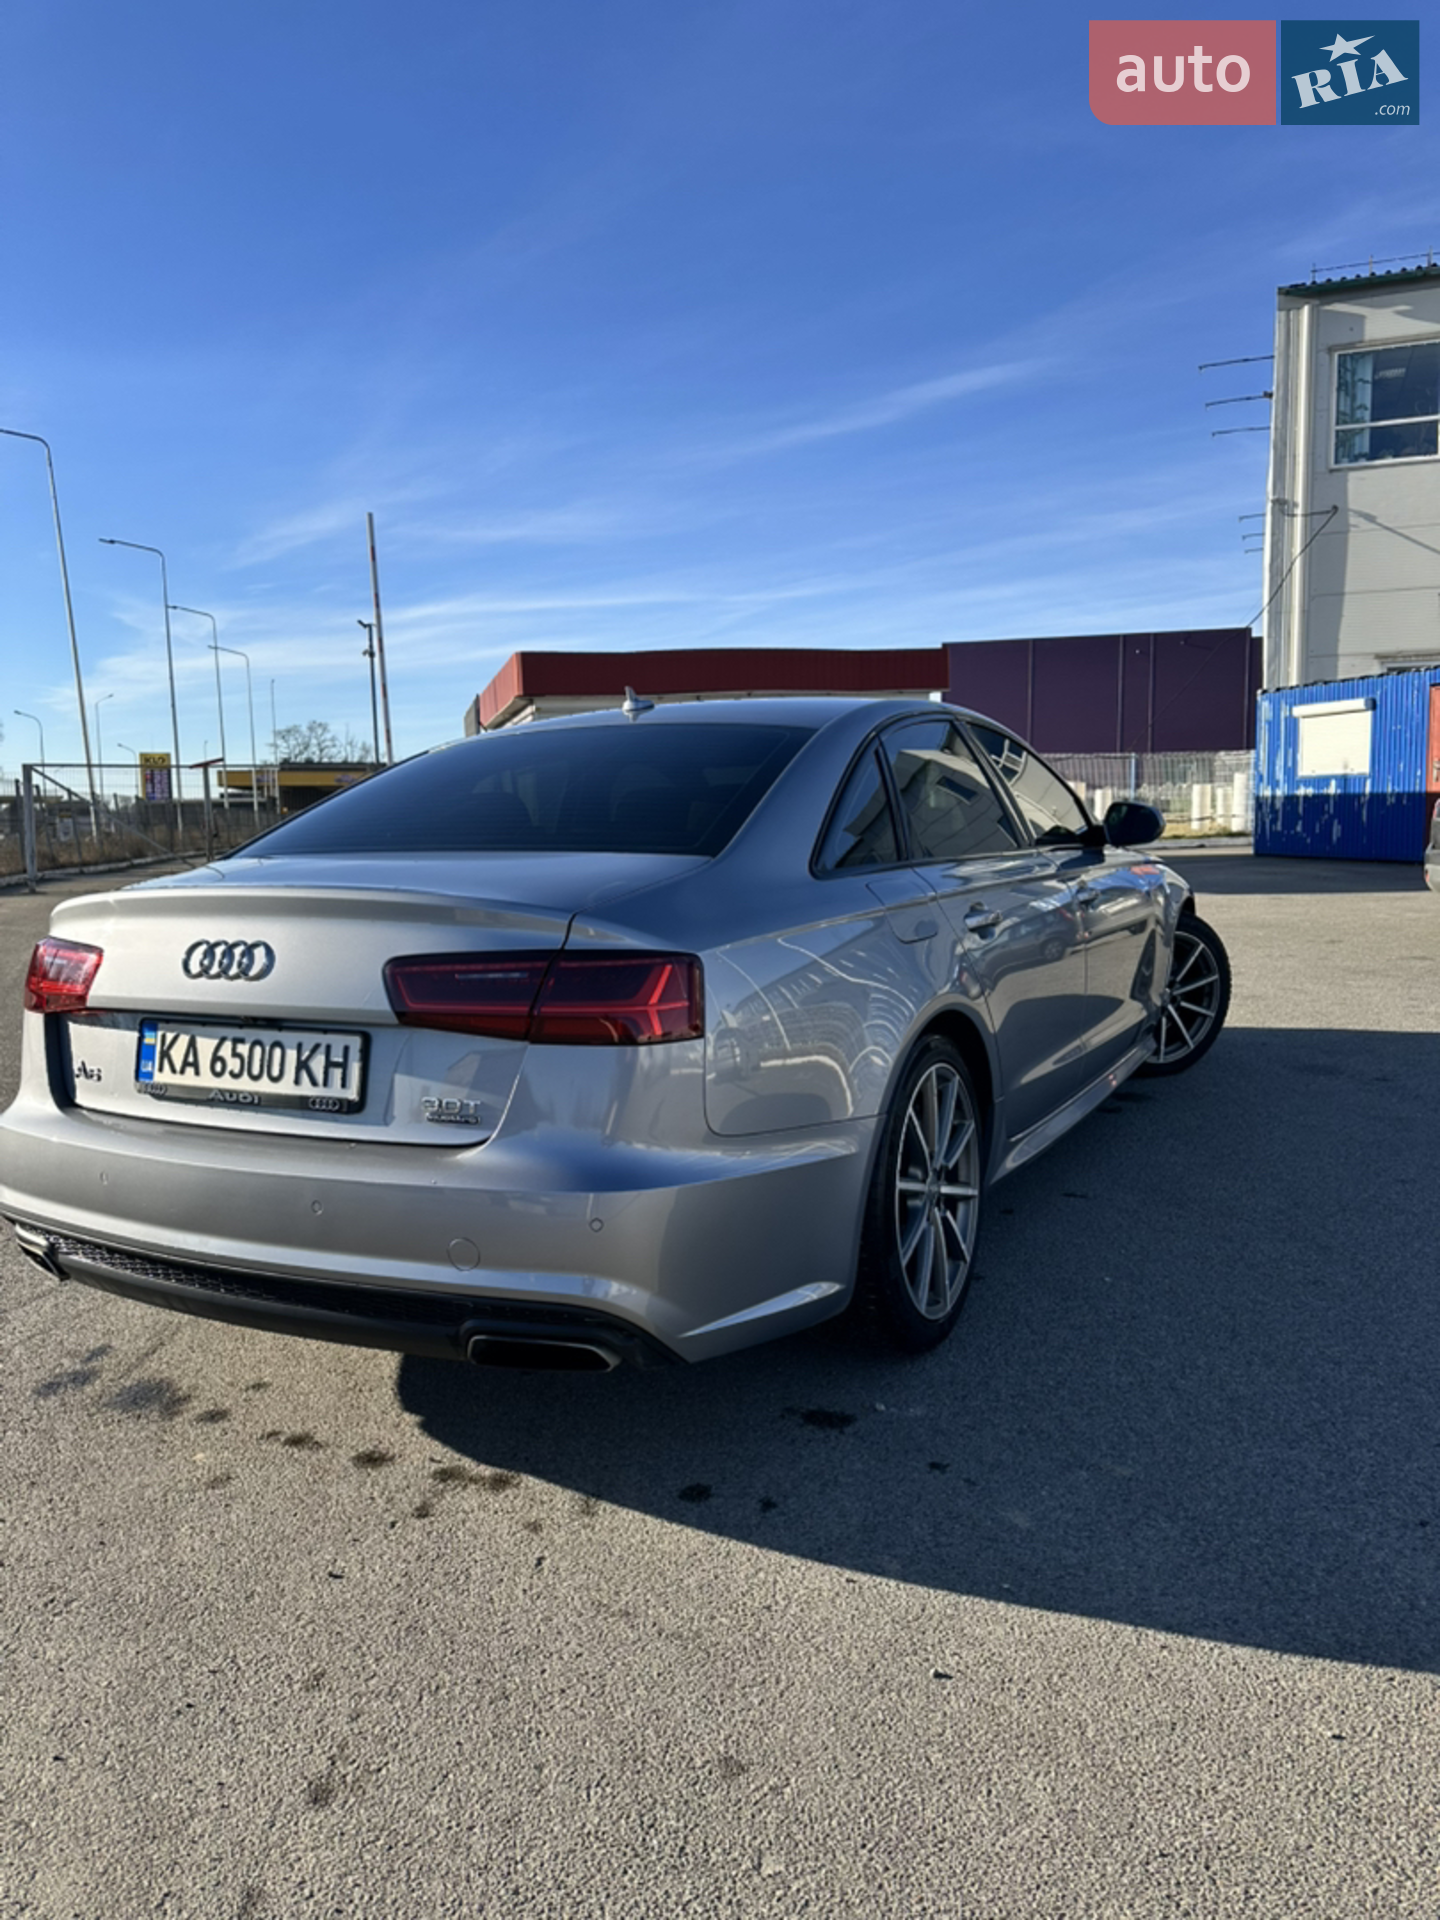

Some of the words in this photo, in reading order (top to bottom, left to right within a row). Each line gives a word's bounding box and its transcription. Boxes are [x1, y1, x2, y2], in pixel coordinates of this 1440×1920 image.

[158, 1032, 200, 1077] KA
[209, 1036, 286, 1084] 6500
[293, 1041, 350, 1089] KH
